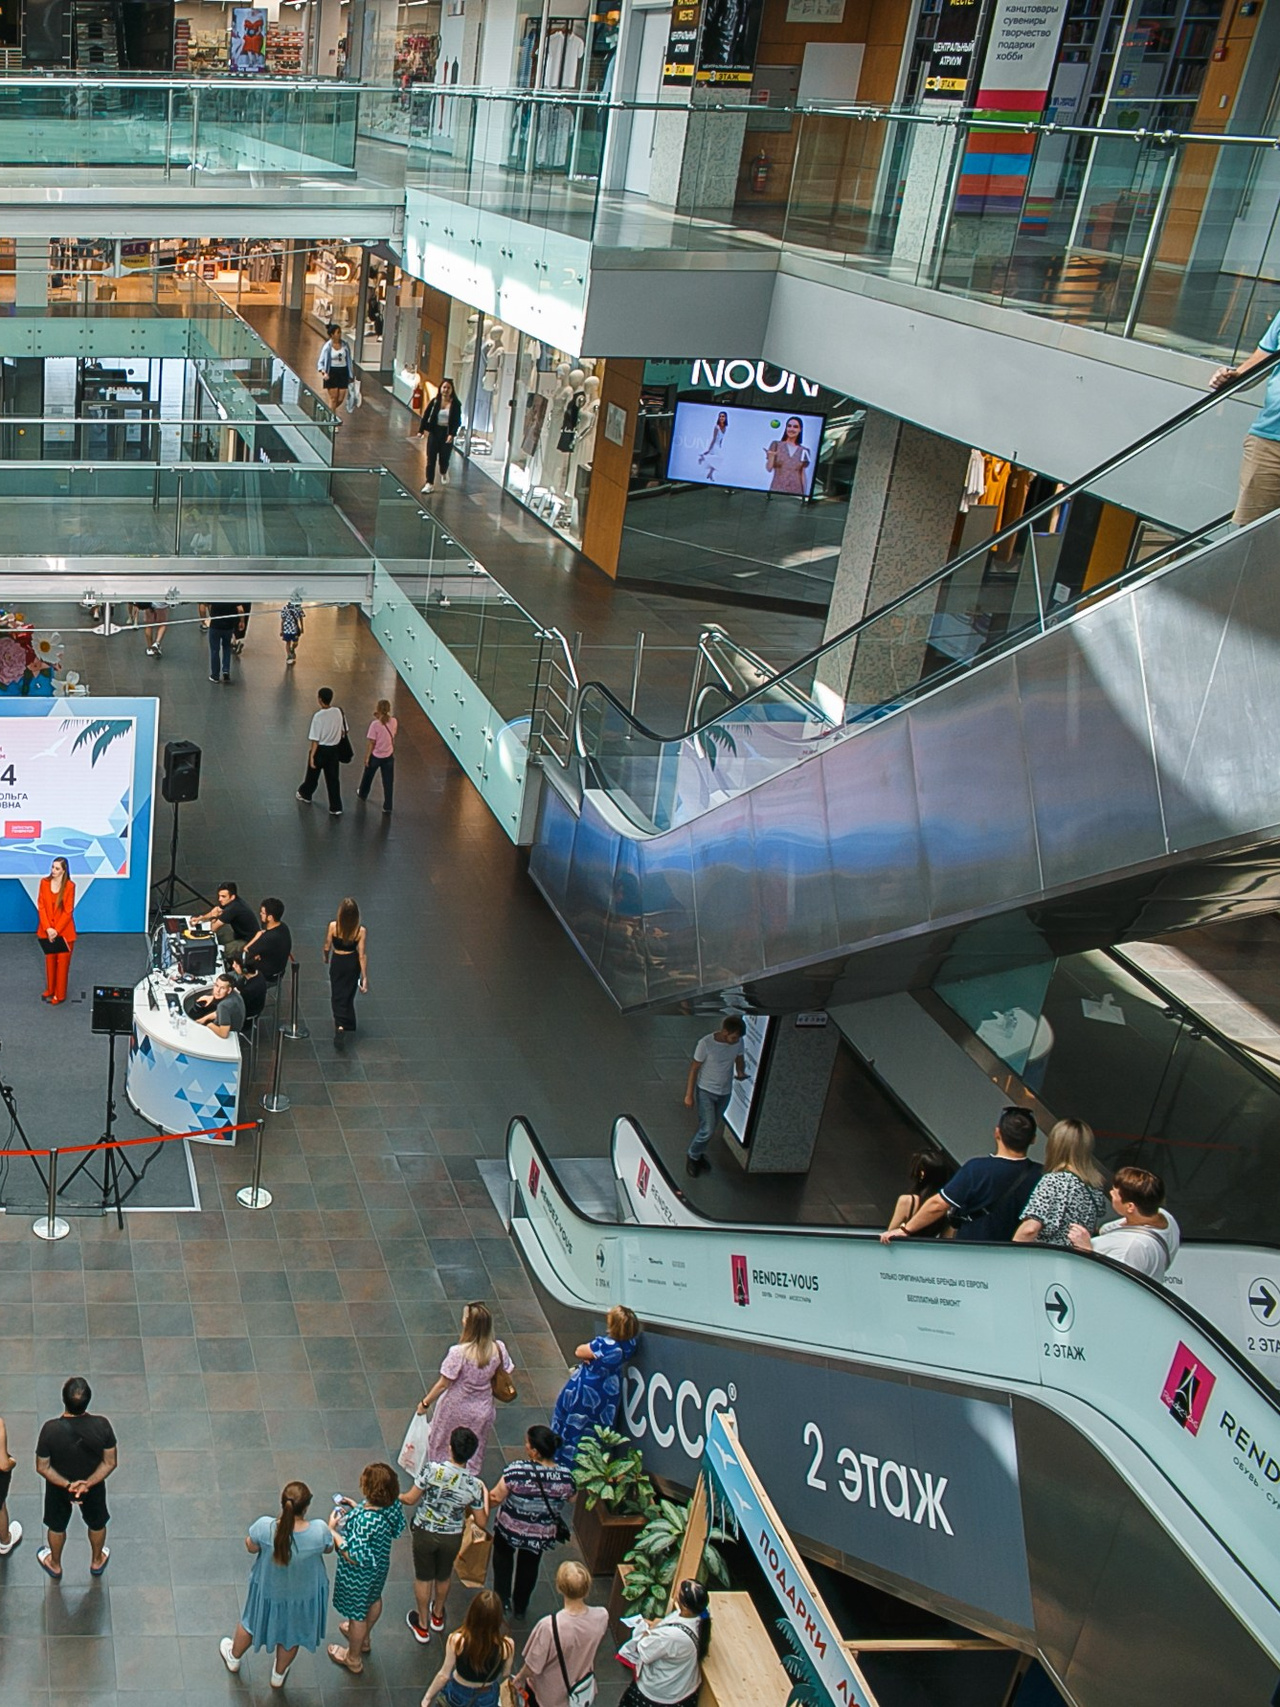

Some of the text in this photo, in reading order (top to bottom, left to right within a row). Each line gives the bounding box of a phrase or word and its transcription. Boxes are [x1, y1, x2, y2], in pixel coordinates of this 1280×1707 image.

[1005, 4, 1059, 15] канцтовары
[1003, 17, 1047, 27] сувениры
[1001, 28, 1052, 38] творчество
[933, 40, 976, 53] ЦЕНТРАЛЬНЫЙ
[997, 41, 1036, 51] подарки
[939, 55, 963, 66] АТРИУМ
[995, 51, 1024, 61] хобби
[709, 70, 717, 82] 3
[752, 1269, 819, 1292] RENDEZ-VOUS
[1248, 1336, 1255, 1351] 2
[1043, 1342, 1087, 1362] 2 ЭТАЖ
[1233, 1456, 1260, 1487] ОБУВЬ
[803, 1421, 955, 1537] 2 этаж
[759, 1529, 827, 1660] ПОДАРКИ
